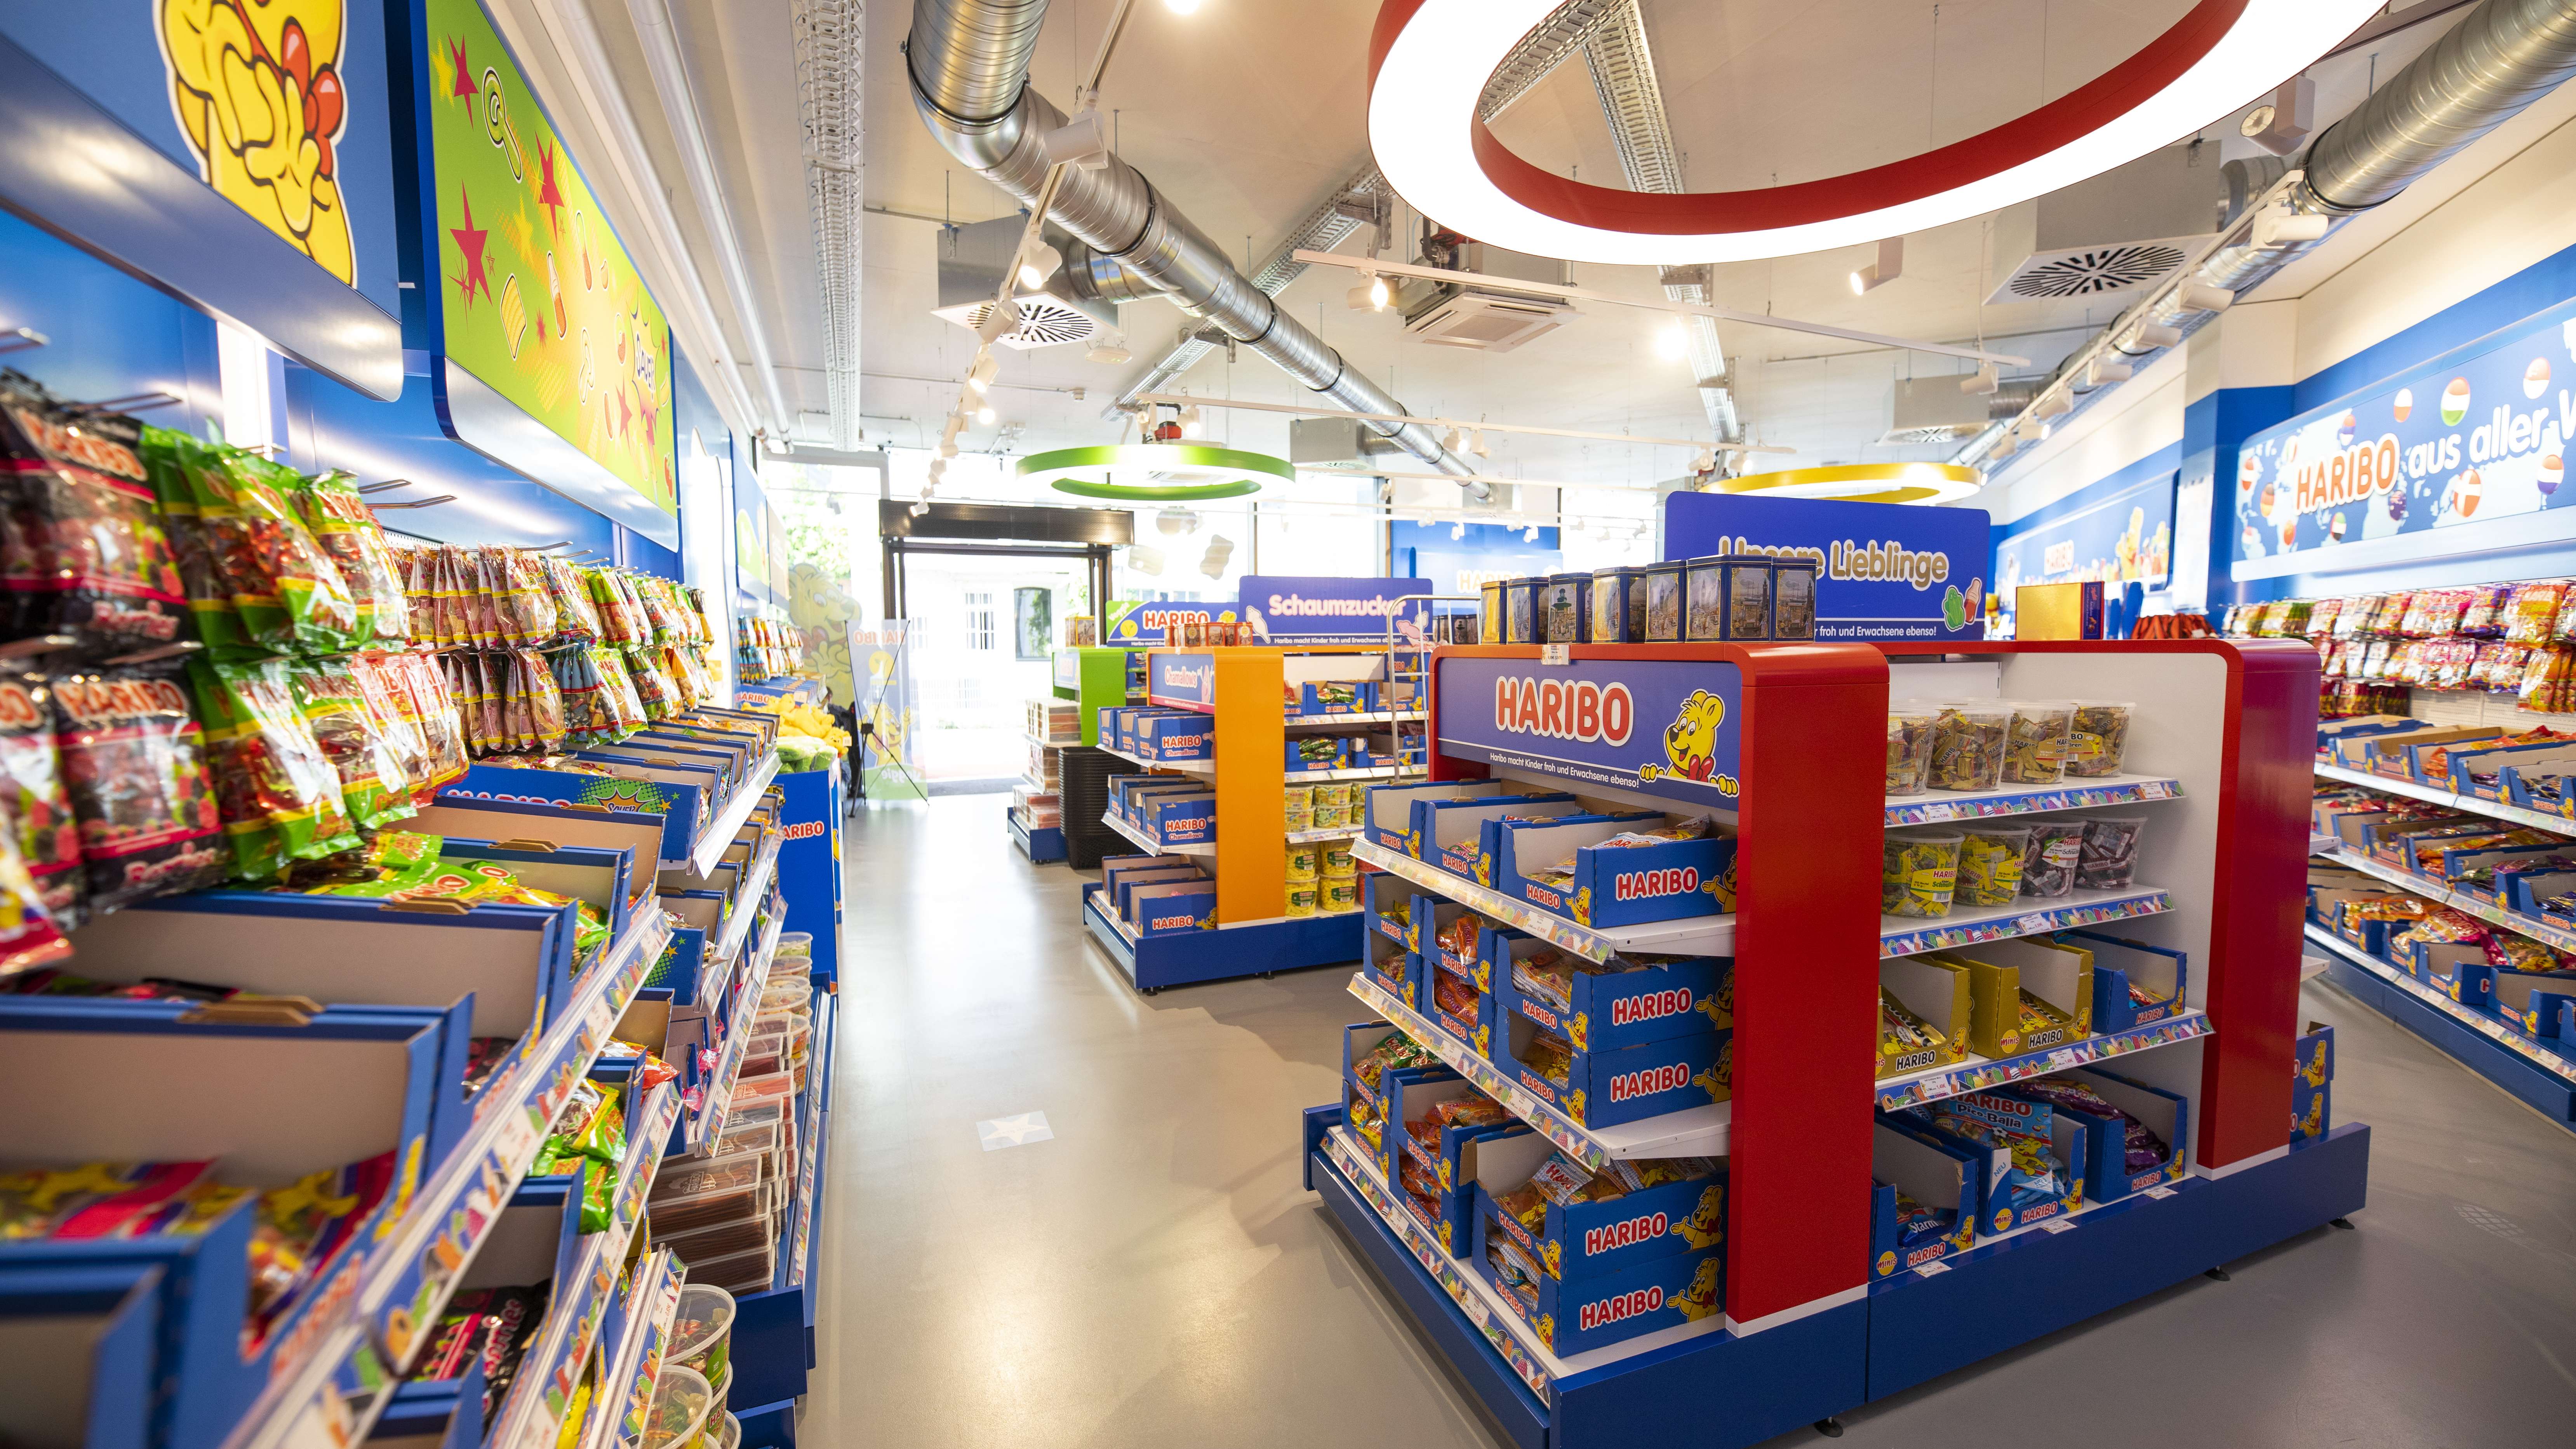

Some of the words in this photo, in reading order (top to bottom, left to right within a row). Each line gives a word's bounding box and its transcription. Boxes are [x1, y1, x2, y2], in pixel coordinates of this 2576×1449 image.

[2296, 437, 2397, 512] HARIBO
[2409, 434, 2461, 478] aus
[2469, 404, 2549, 463] aller
[1830, 540, 1948, 590] Lieblinge
[1143, 610, 1211, 630] HARIBO
[1820, 626, 1837, 637] froh
[1838, 626, 1855, 637] und
[1857, 626, 1904, 637] Erwachsene
[1906, 626, 1936, 637] ebenso!
[1165, 665, 1197, 688] Chamallows
[52, 679, 189, 722] HARIBO
[1497, 677, 1633, 746] HARIBO
[1162, 736, 1202, 748] HARIBO
[1490, 752, 1506, 763] Haribo
[1508, 754, 1524, 766] macht
[1525, 757, 1543, 771] Kinder
[1544, 761, 1556, 772] froh
[1557, 764, 1569, 775] und
[1570, 767, 1609, 783] Erwachsene
[1610, 774, 1639, 788] ebenso!
[2532, 799, 2558, 813] HARIBO
[782, 821, 824, 840] ARIBO
[1166, 818, 1206, 832] HARIBO
[1380, 832, 1401, 850] HARIBO
[1442, 853, 1468, 874] HARIBO
[1933, 870, 1957, 878] HARIBO
[1616, 866, 1698, 901] HARIBO
[1526, 884, 1560, 909] HARIBO
[1152, 916, 1194, 930] HARIBO
[1381, 920, 1401, 940] HARIBO
[2541, 913, 2571, 930] HARIBO
[1442, 953, 1468, 978] HARIBO
[1378, 973, 1397, 995] HARIBO
[1523, 999, 1557, 1029] HARIBO
[1612, 987, 1692, 1026] HARIBO
[2135, 1007, 2164, 1025] HARIBO
[2501, 1004, 2521, 1023] HARIBO
[1441, 1013, 1467, 1040] HARIBO
[2001, 1036, 2019, 1046] minis
[2028, 1028, 2063, 1049] HARIBO
[1896, 1050, 1936, 1071] HARIBO
[1356, 1079, 1374, 1106] HARIBO
[1521, 1070, 1555, 1103] HARIBO
[1611, 1062, 1690, 1103] HARIBO
[1518, 1106, 1527, 1116] 0,85€
[1957, 1104, 2023, 1129] Pico-Balla
[1355, 1133, 1374, 1161] HARIBO
[1407, 1138, 1431, 1171] HARIBO
[1993, 1162, 2006, 1177] NEU
[2131, 1171, 2162, 1191] HARIBO
[1406, 1196, 1431, 1230] HARIBO
[1994, 1214, 2014, 1225] minis
[2021, 1201, 2058, 1224] HARIBO
[1498, 1211, 1532, 1249] HARIBO
[1585, 1212, 1668, 1256] HARIBO
[1876, 1257, 1898, 1270] minis
[1907, 1242, 1946, 1267] HARIBO
[1496, 1277, 1526, 1320] HARIBO
[1580, 1285, 1663, 1331] HARIBO
[1473, 1311, 1482, 1322] 0,85€
